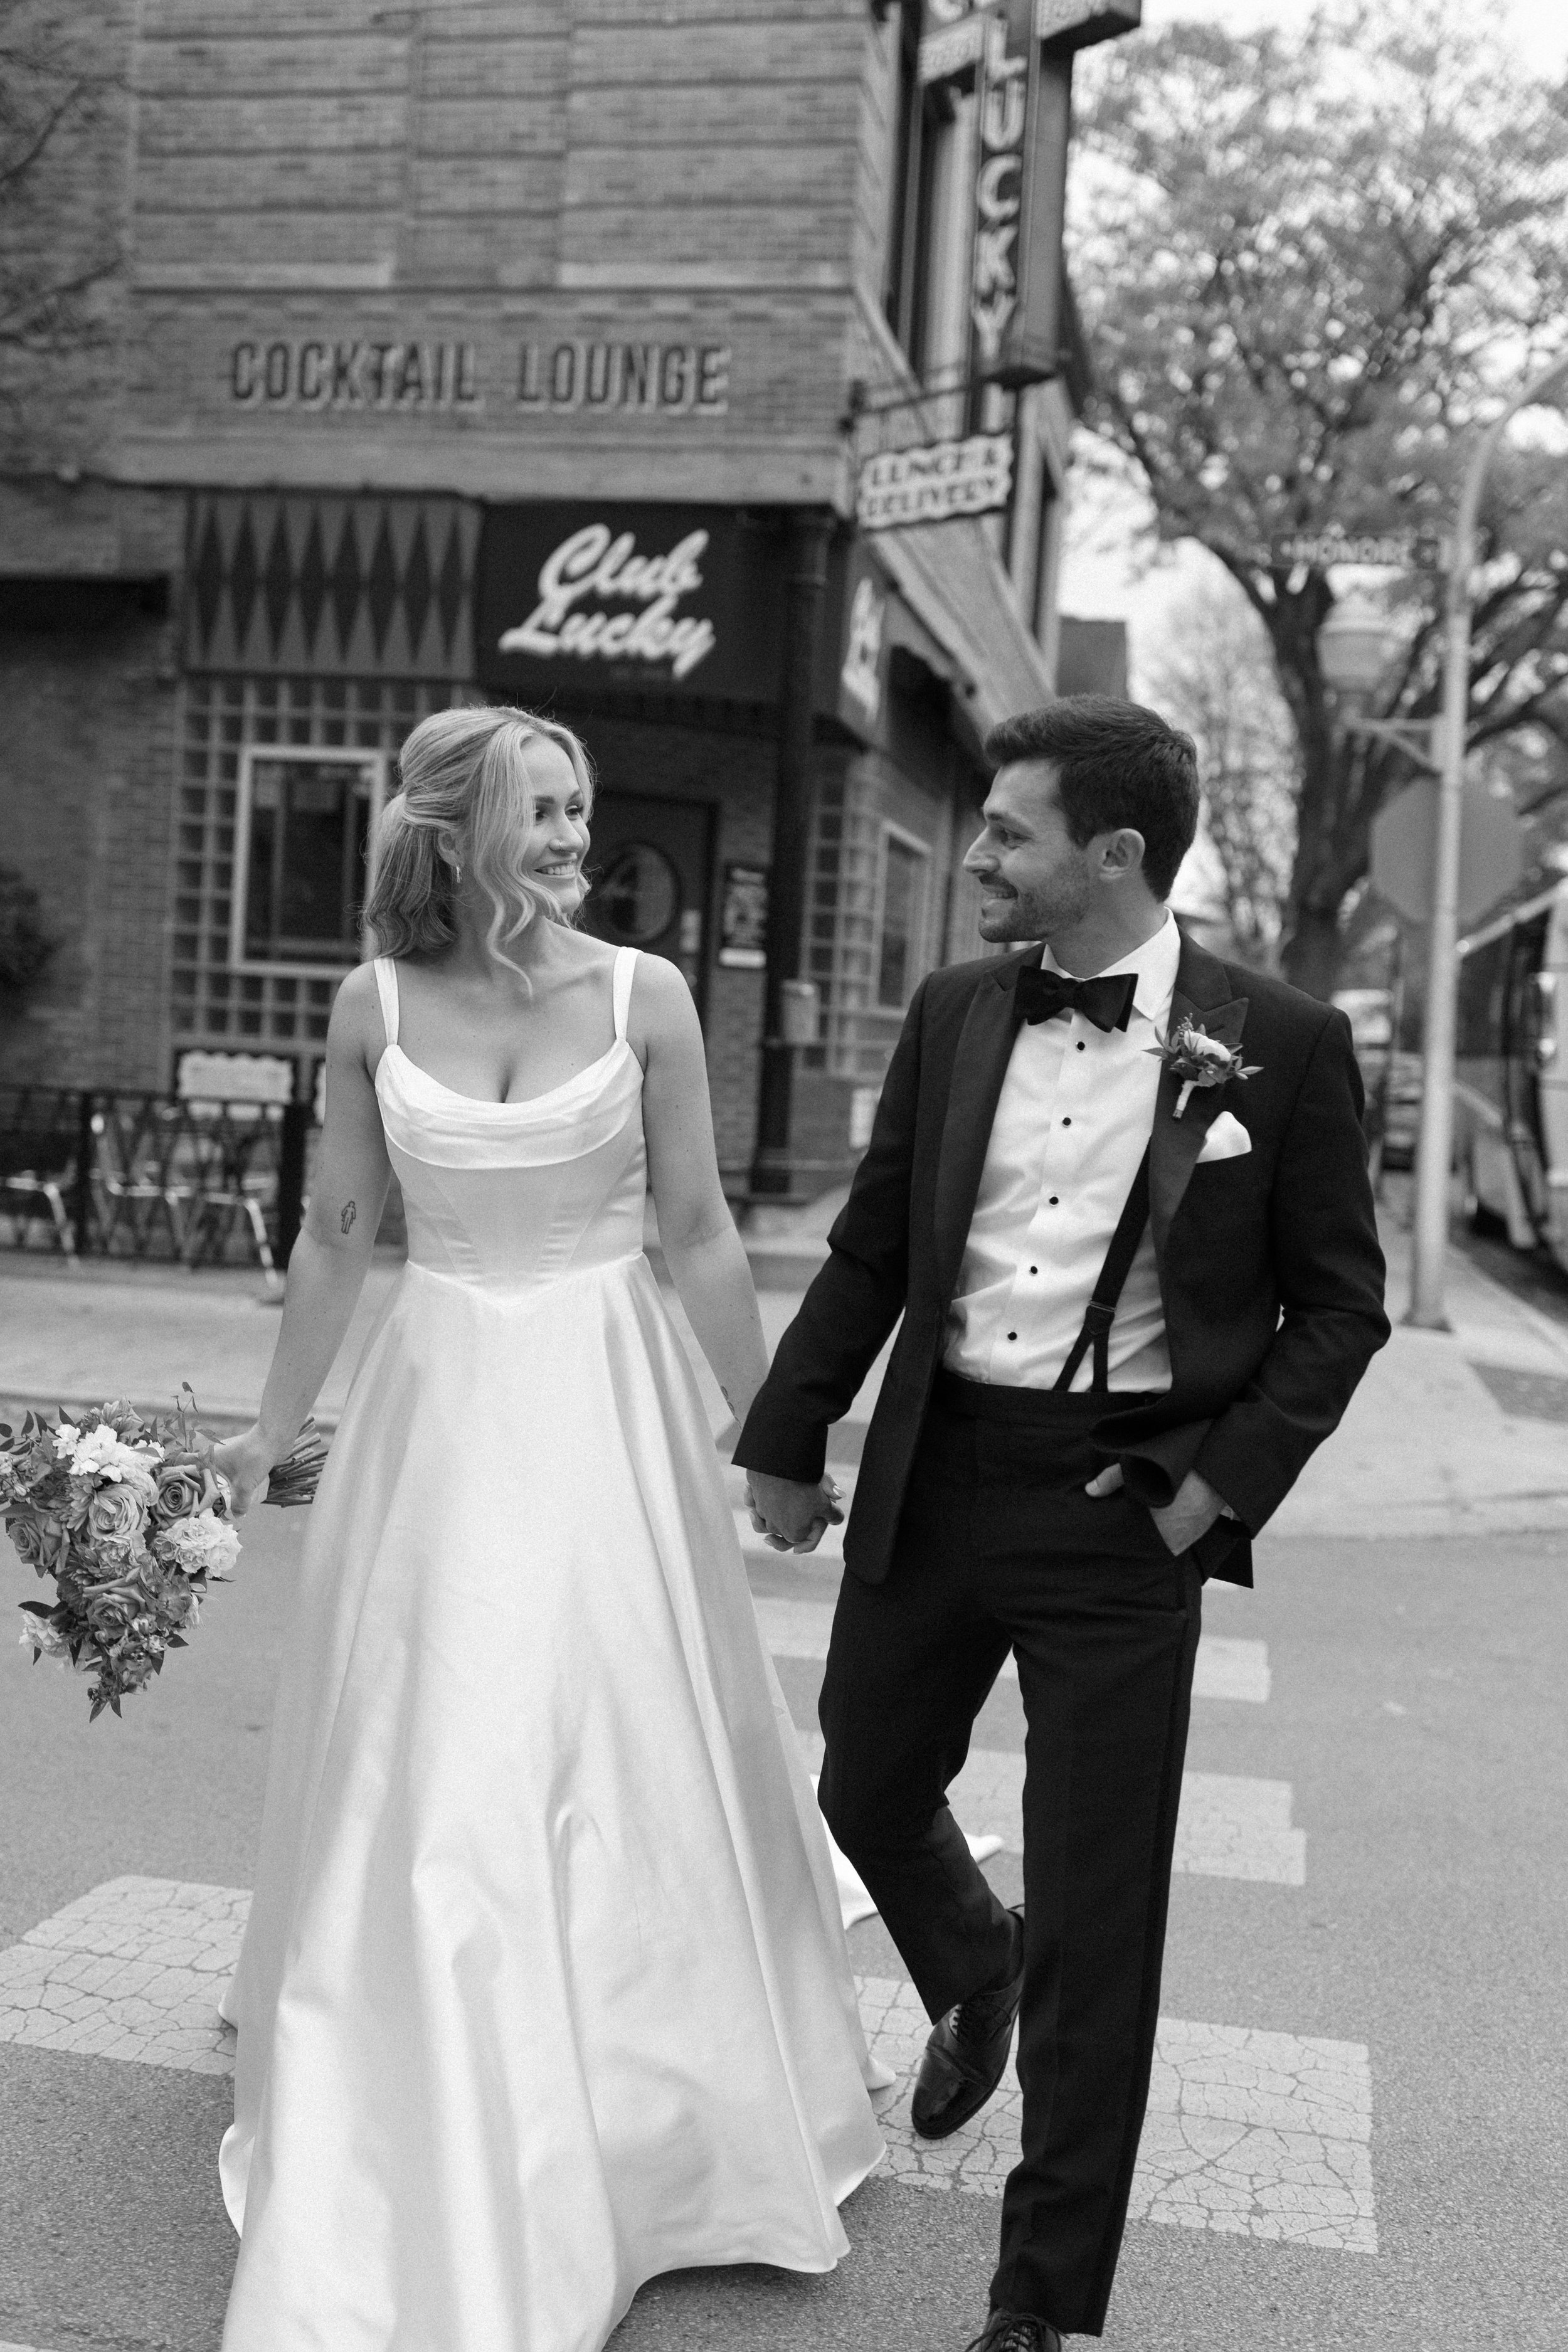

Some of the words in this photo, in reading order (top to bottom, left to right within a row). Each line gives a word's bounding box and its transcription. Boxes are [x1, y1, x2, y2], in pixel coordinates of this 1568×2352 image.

[974, 16, 1027, 359] LUCKY
[232, 341, 483, 411] COCKTAIL
[517, 342, 733, 416] LOUNGE
[538, 523, 709, 599] Club
[498, 593, 716, 682] Lucky
